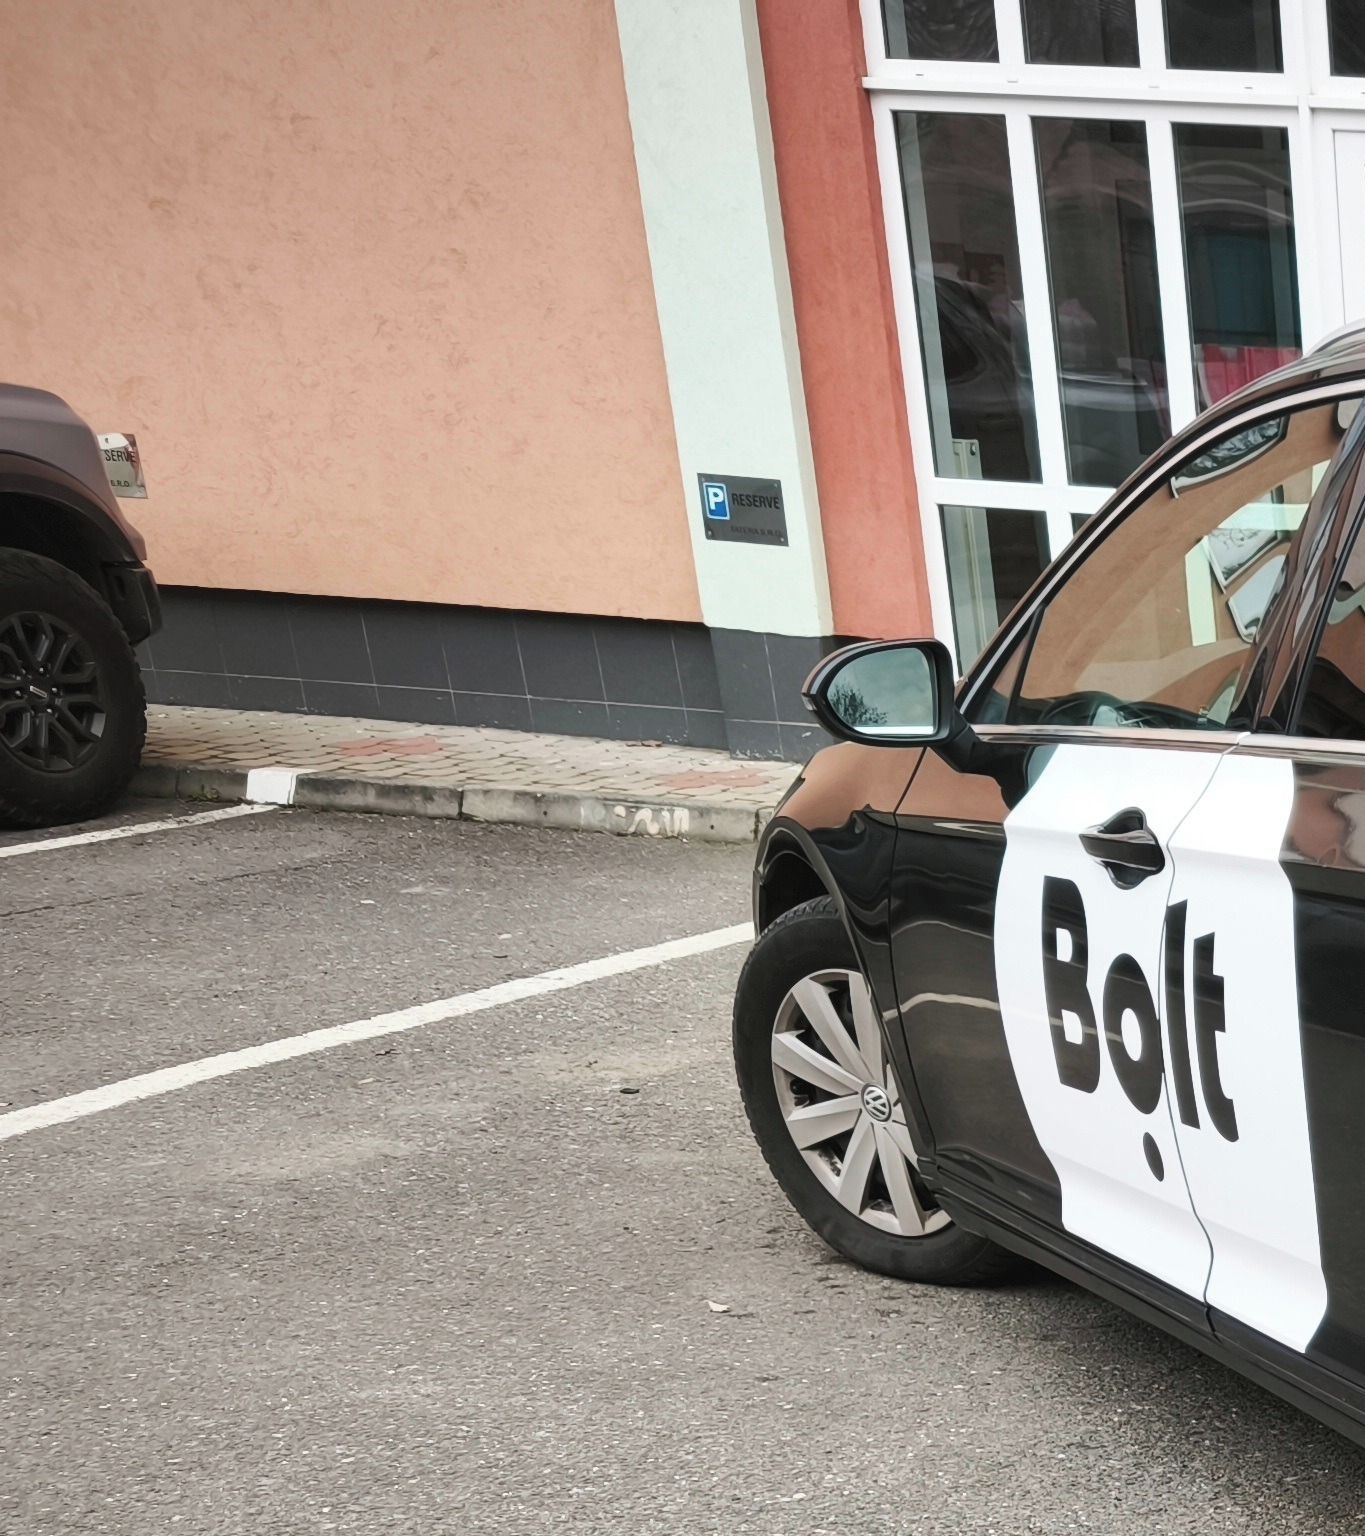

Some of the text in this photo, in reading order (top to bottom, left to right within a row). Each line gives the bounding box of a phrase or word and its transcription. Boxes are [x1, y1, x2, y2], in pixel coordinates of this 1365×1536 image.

[104, 449, 136, 463] SERVE
[707, 487, 724, 510] P
[1042, 875, 1239, 1182] Bolt
